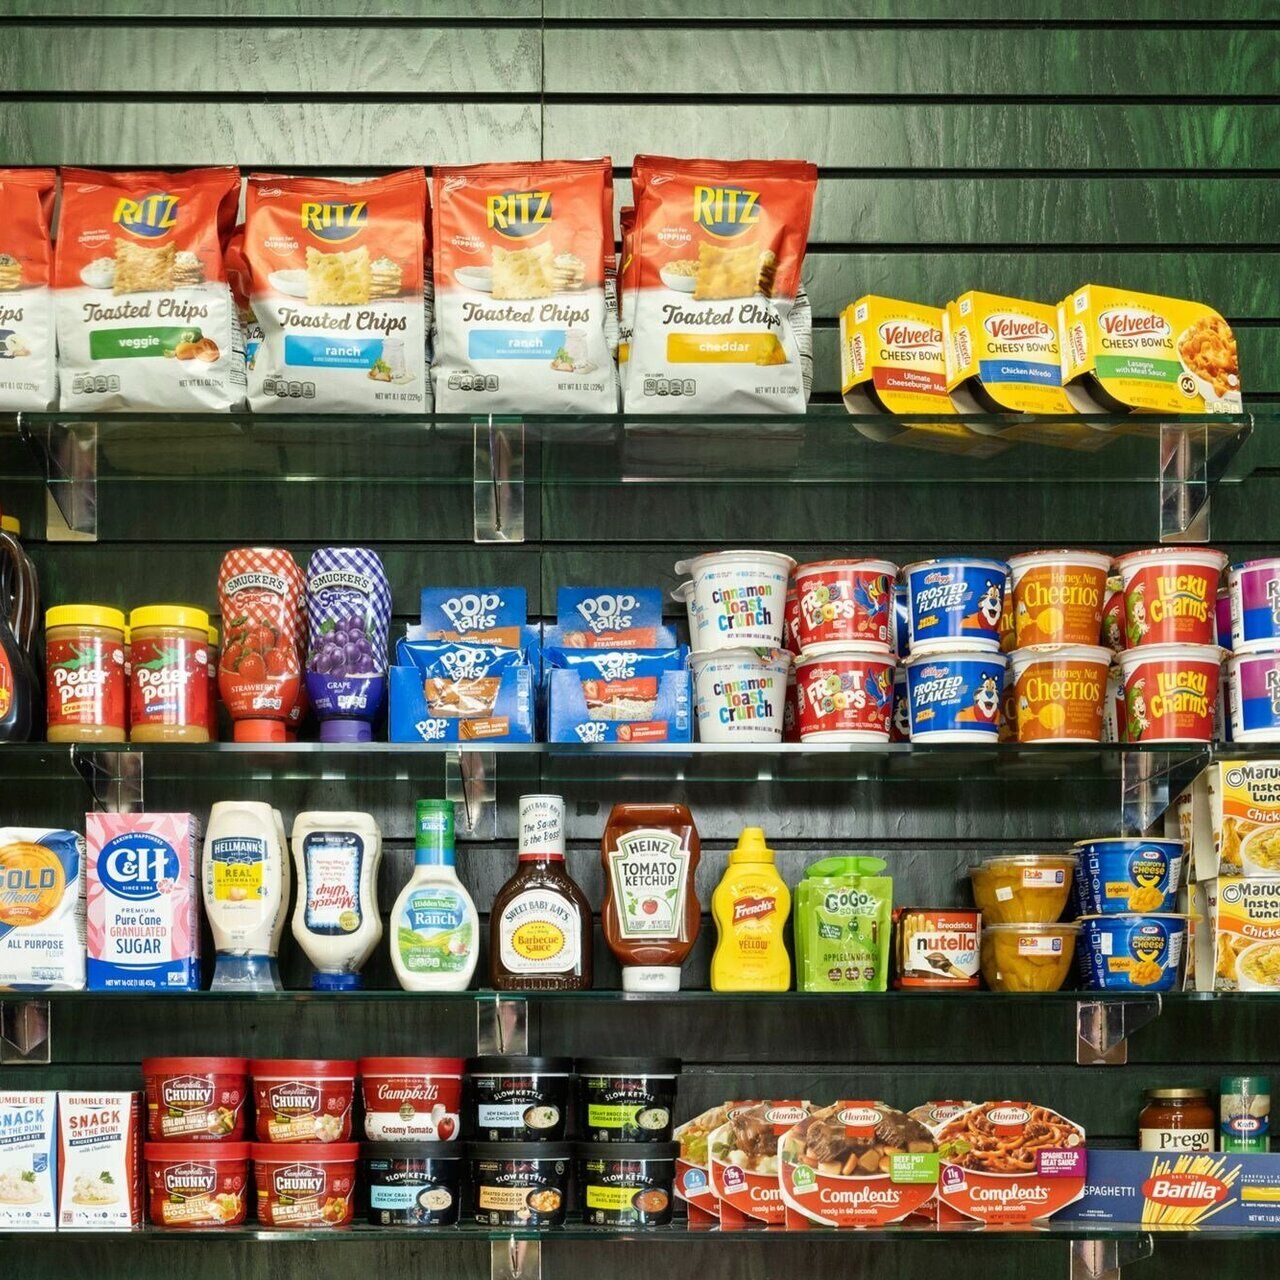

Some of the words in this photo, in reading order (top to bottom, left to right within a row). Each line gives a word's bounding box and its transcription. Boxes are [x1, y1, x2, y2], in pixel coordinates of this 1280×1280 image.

[990, 319, 1048, 341] Velveeta
[119, 335, 159, 349] veggie
[699, 341, 750, 353] cheddar
[1101, 337, 1139, 349] CHEESY
[1141, 338, 1173, 349] BOWLS
[325, 344, 361, 357] ranch
[1001, 367, 1029, 376] Chicken
[227, 574, 285, 592] SMUCKER'S
[1052, 574, 1081, 587] Honey
[1083, 573, 1099, 584] Nut
[1157, 574, 1207, 598] Lucky
[916, 582, 968, 604] FROSTED
[1025, 583, 1098, 607] Cheerios
[731, 599, 763, 614] Toast
[919, 593, 962, 612] FLAKES
[1151, 596, 1210, 622] Charms
[137, 668, 192, 688] Peter
[231, 684, 278, 692] STRAWBERRY
[327, 682, 351, 690] GRAPE
[215, 840, 264, 854] HELLMANN'S
[630, 843, 670, 856] HEINZ
[106, 849, 168, 882] C&H
[622, 863, 677, 876] TOMATO
[225, 869, 252, 878] REAL
[625, 875, 675, 887] KETCHUP
[734, 899, 776, 923] French's
[115, 914, 135, 926] Pure
[138, 915, 161, 925] Cane
[414, 911, 458, 926] Ranch
[938, 921, 973, 930] Breadsticks
[111, 926, 166, 937] GRANULATED
[8, 940, 27, 950] ALL
[29, 940, 64, 950] PURPOSE
[116, 938, 161, 954] SUGAR
[518, 936, 559, 946] Barbecue
[917, 934, 975, 955] nutella
[525, 943, 551, 954] Sauce
[377, 1084, 439, 1101] Campbell's
[272, 1093, 318, 1108] CHUNKY
[992, 1110, 1026, 1123] Hormel
[381, 1126, 407, 1136] Creamy
[410, 1126, 433, 1134] Tomato
[1159, 1131, 1209, 1151] Prego
[820, 1188, 900, 1207] Compleats
[1084, 1186, 1135, 1198] SPAGHETTI
[1152, 1181, 1217, 1200] Barilla
